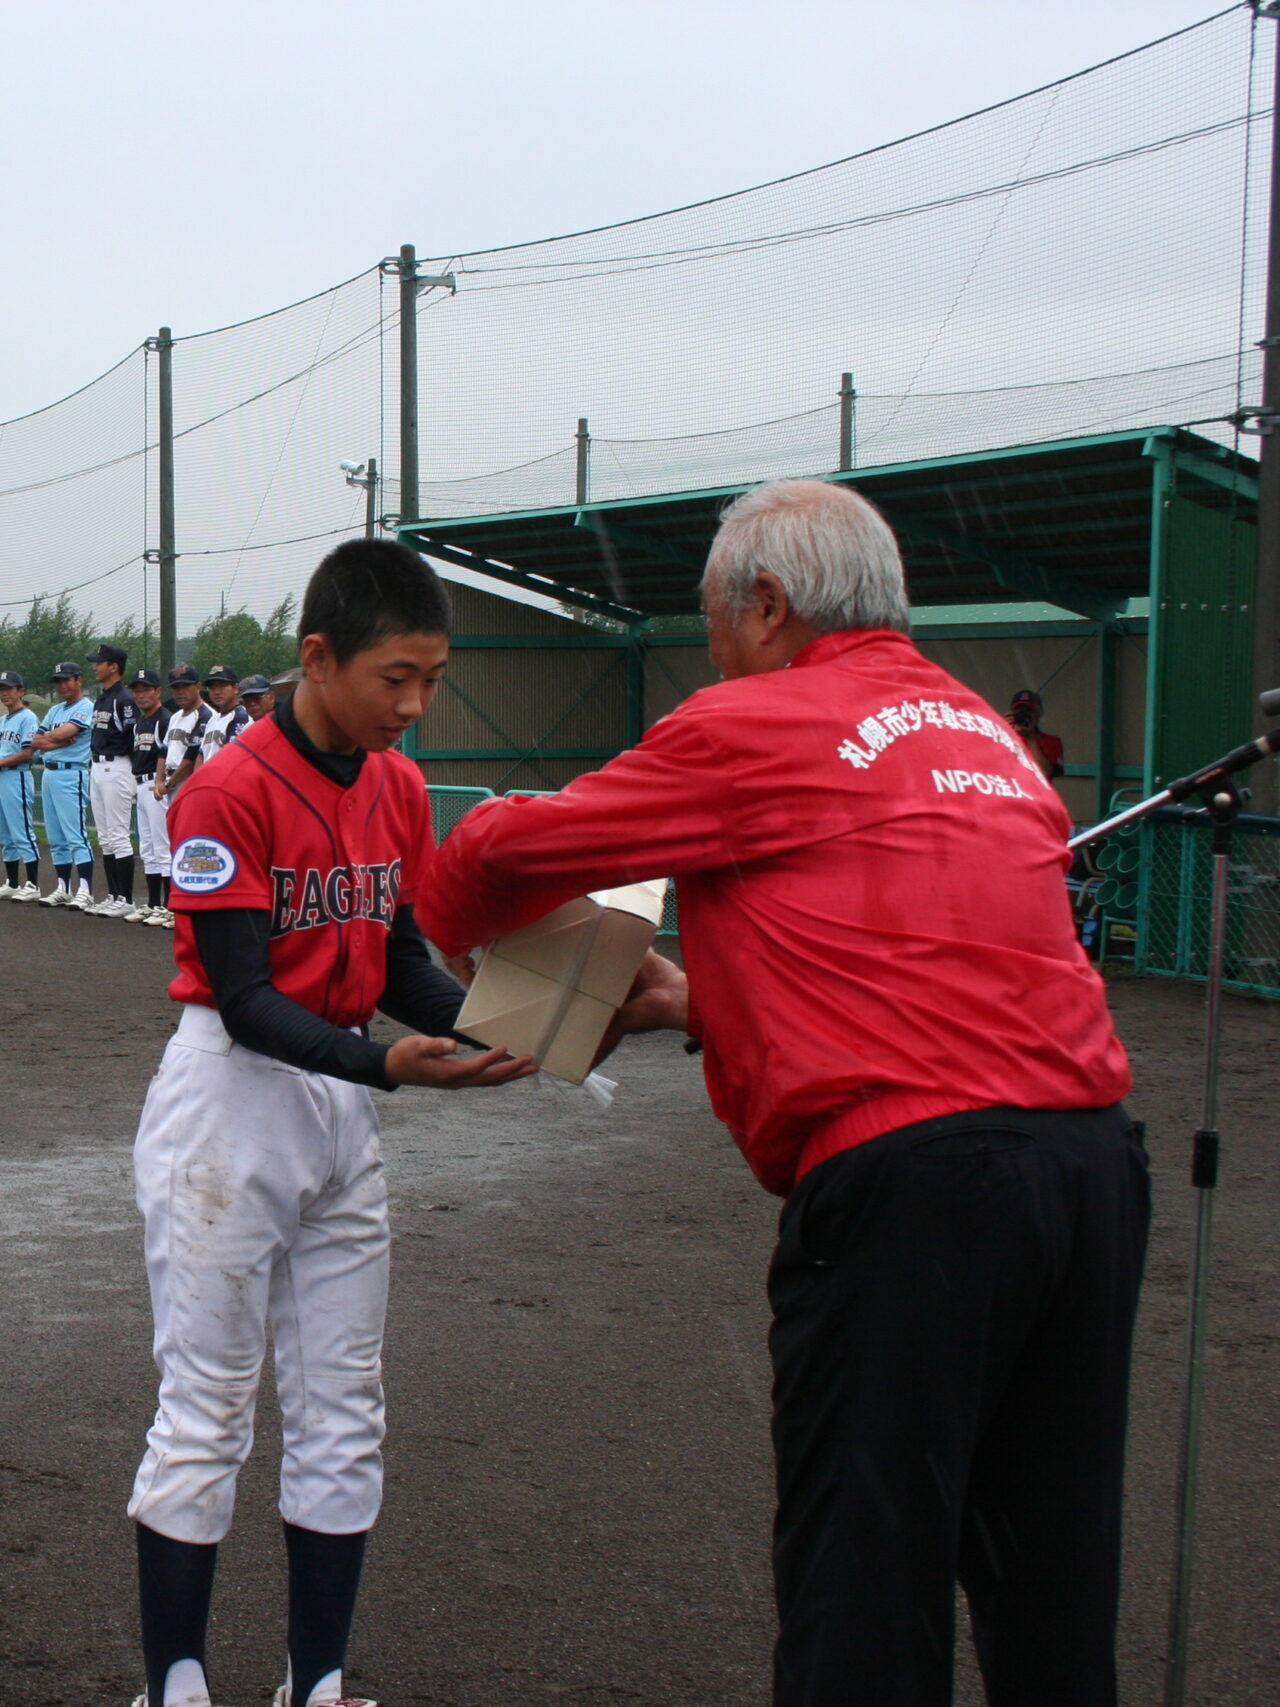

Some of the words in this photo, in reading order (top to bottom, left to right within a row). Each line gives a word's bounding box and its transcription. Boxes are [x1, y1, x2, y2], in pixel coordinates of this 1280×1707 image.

[0, 672, 8, 681] H
[138, 670, 145, 679] S
[930, 769, 1034, 801] NPO法人
[269, 857, 402, 941] EAGLES
